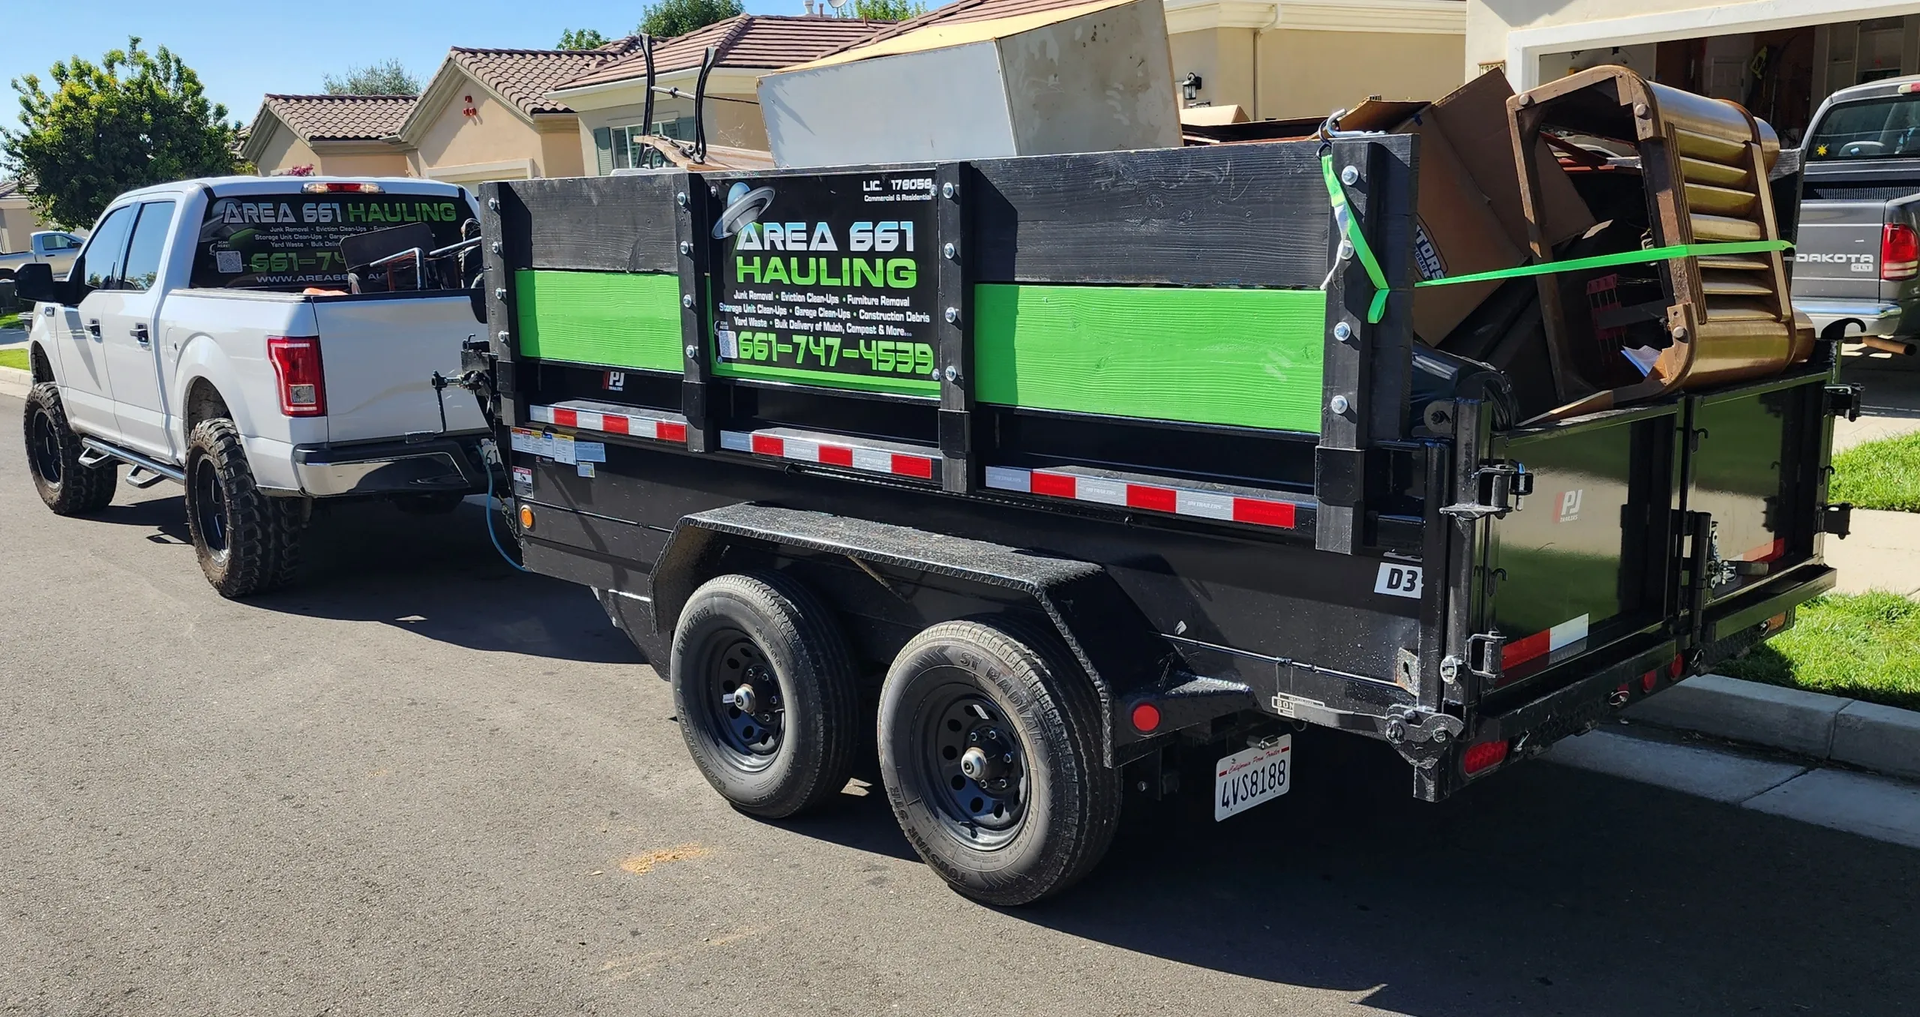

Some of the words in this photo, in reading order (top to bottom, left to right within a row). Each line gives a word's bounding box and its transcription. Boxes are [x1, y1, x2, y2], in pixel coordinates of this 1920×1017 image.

[863, 180, 882, 191] LIC.
[864, 194, 895, 202] Commercial
[902, 193, 932, 201] Residential
[223, 203, 297, 223] AREA
[302, 203, 342, 223] 661
[347, 202, 457, 222] HAULING
[736, 221, 838, 251] AREA
[850, 221, 914, 252] 661
[1795, 253, 1874, 263] DAKOTA
[736, 256, 917, 289] HAULING
[733, 289, 748, 300] Junk
[749, 290, 773, 301] Removal
[781, 291, 806, 302] Eviction
[807, 292, 839, 305] Clean-Ups
[847, 294, 879, 306] Furniture
[880, 295, 910, 307] Removal
[719, 302, 742, 314] Storage
[743, 303, 756, 313] Unit
[757, 304, 787, 317] Clean-Ups
[794, 306, 817, 319] Garage
[818, 307, 851, 320] Clean-Ups
[859, 309, 904, 321] Construction
[906, 311, 930, 323] Debris
[733, 316, 748, 326] Yard
[749, 317, 767, 328] Waste
[774, 319, 788, 329] Bulk
[789, 320, 814, 332] Delivery
[815, 321, 823, 331] of
[823, 322, 845, 334] Mulch,
[846, 323, 877, 335] Compost
[878, 324, 884, 335] &
[737, 331, 934, 374] 661-747-4539
[609, 371, 625, 387] PJ
[1561, 489, 1583, 516] PJ
[1386, 568, 1417, 592] D3
[985, 666, 1042, 745] RADIAL
[1228, 761, 1251, 774] California
[1221, 759, 1286, 808] 4VS8188
